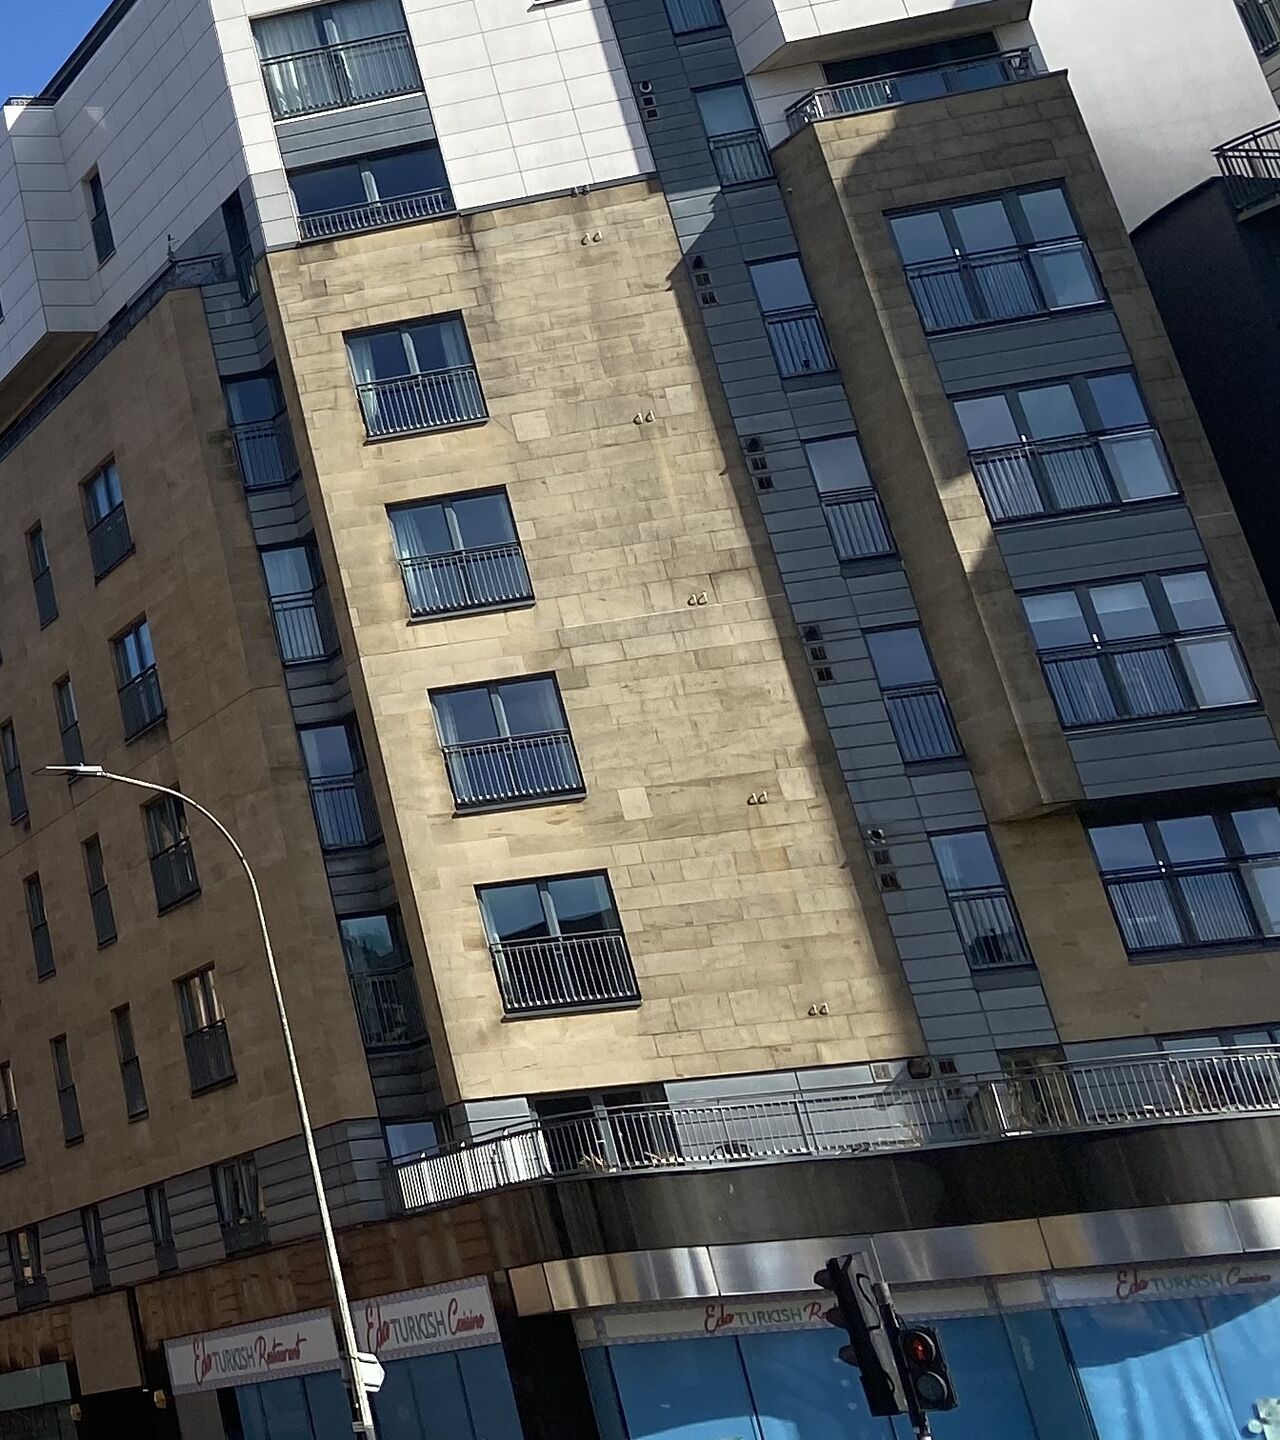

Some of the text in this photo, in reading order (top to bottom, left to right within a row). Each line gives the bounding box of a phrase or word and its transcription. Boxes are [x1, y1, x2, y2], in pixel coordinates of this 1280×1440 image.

[1149, 1273, 1224, 1292] TURKISH
[390, 1311, 448, 1344] TURKISH
[734, 1308, 803, 1326] TURKISH
[213, 1345, 255, 1374] TURKISH
